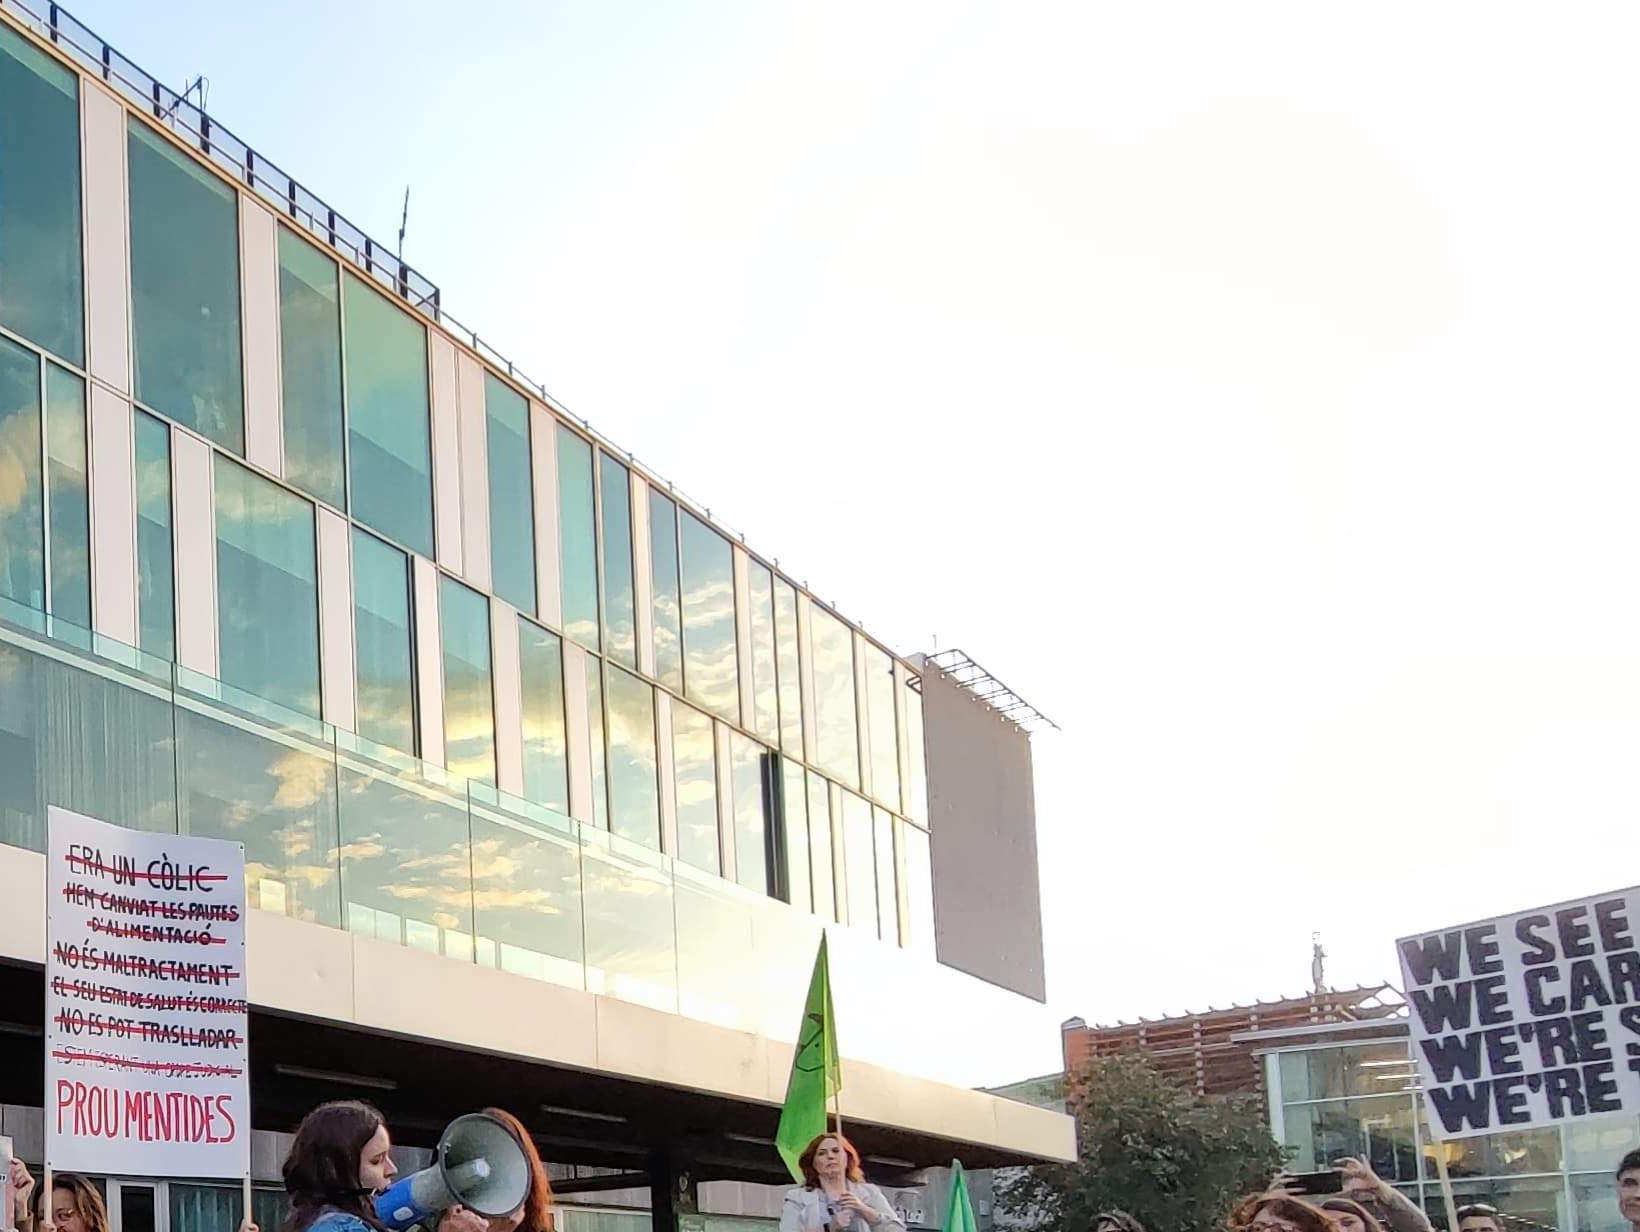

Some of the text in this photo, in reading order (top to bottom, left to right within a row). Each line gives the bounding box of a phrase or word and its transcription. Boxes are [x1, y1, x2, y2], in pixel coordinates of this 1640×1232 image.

[69, 845, 214, 892] ERA UN CÒLIC
[66, 881, 239, 922] HEM CANVIAT LES PAUTES
[56, 937, 233, 986] NO ÉS MALTRACTAMENT
[1399, 898, 1635, 986] WE SEE
[54, 976, 67, 998] EL
[73, 979, 96, 1001] SEU
[1408, 974, 1514, 1035] WE
[60, 1007, 238, 1049] NO ES POT TRASLLADAR
[1419, 1010, 1613, 1083] WE'RE
[56, 1079, 237, 1144] PROU MENTIDES
[1428, 1061, 1623, 1134] WE'RE
